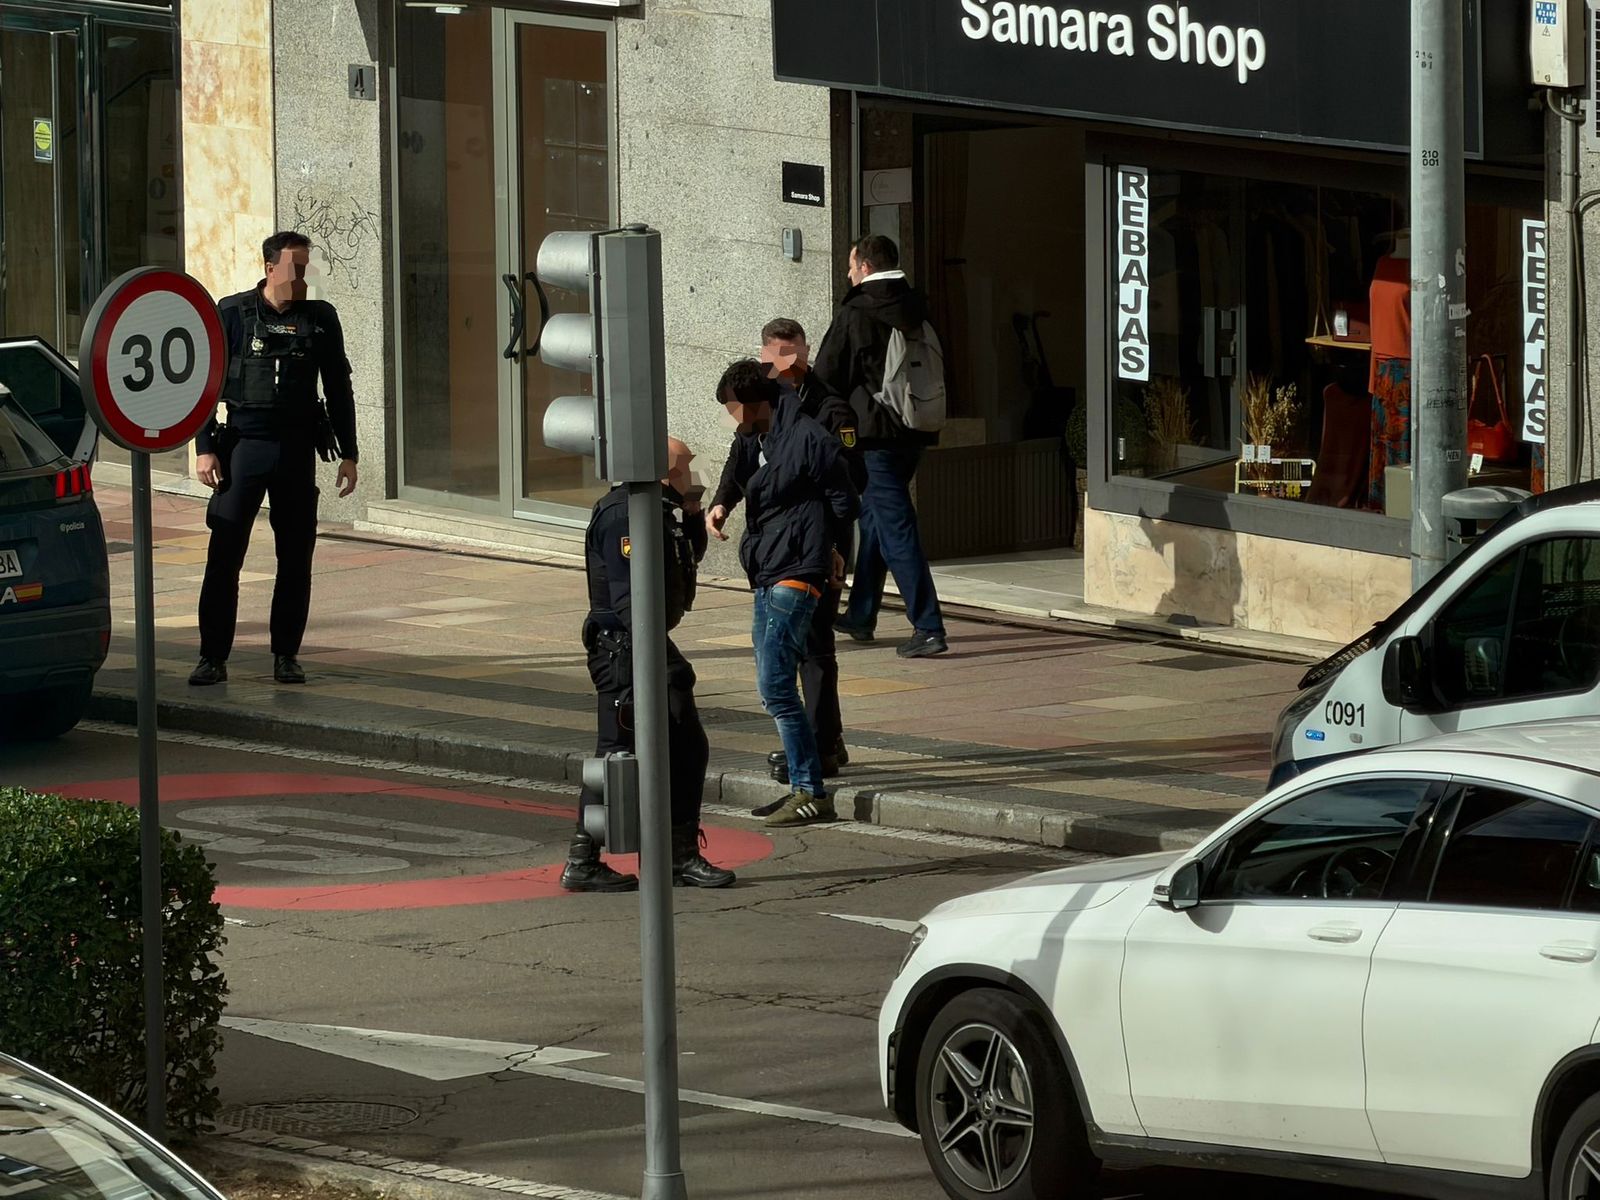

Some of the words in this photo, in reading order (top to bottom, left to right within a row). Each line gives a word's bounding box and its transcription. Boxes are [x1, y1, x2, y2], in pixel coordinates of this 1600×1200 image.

[961, 0, 1135, 57] Samara
[1147, 4, 1266, 84] Shop
[354, 68, 365, 97] 4
[1421, 150, 1439, 159] 210
[1422, 158, 1439, 166] 001
[790, 191, 808, 200] Samara
[808, 193, 820, 202] Shop
[1120, 171, 1148, 373] REBAJAS
[121, 327, 195, 392] 30
[1333, 701, 1365, 728] 091
